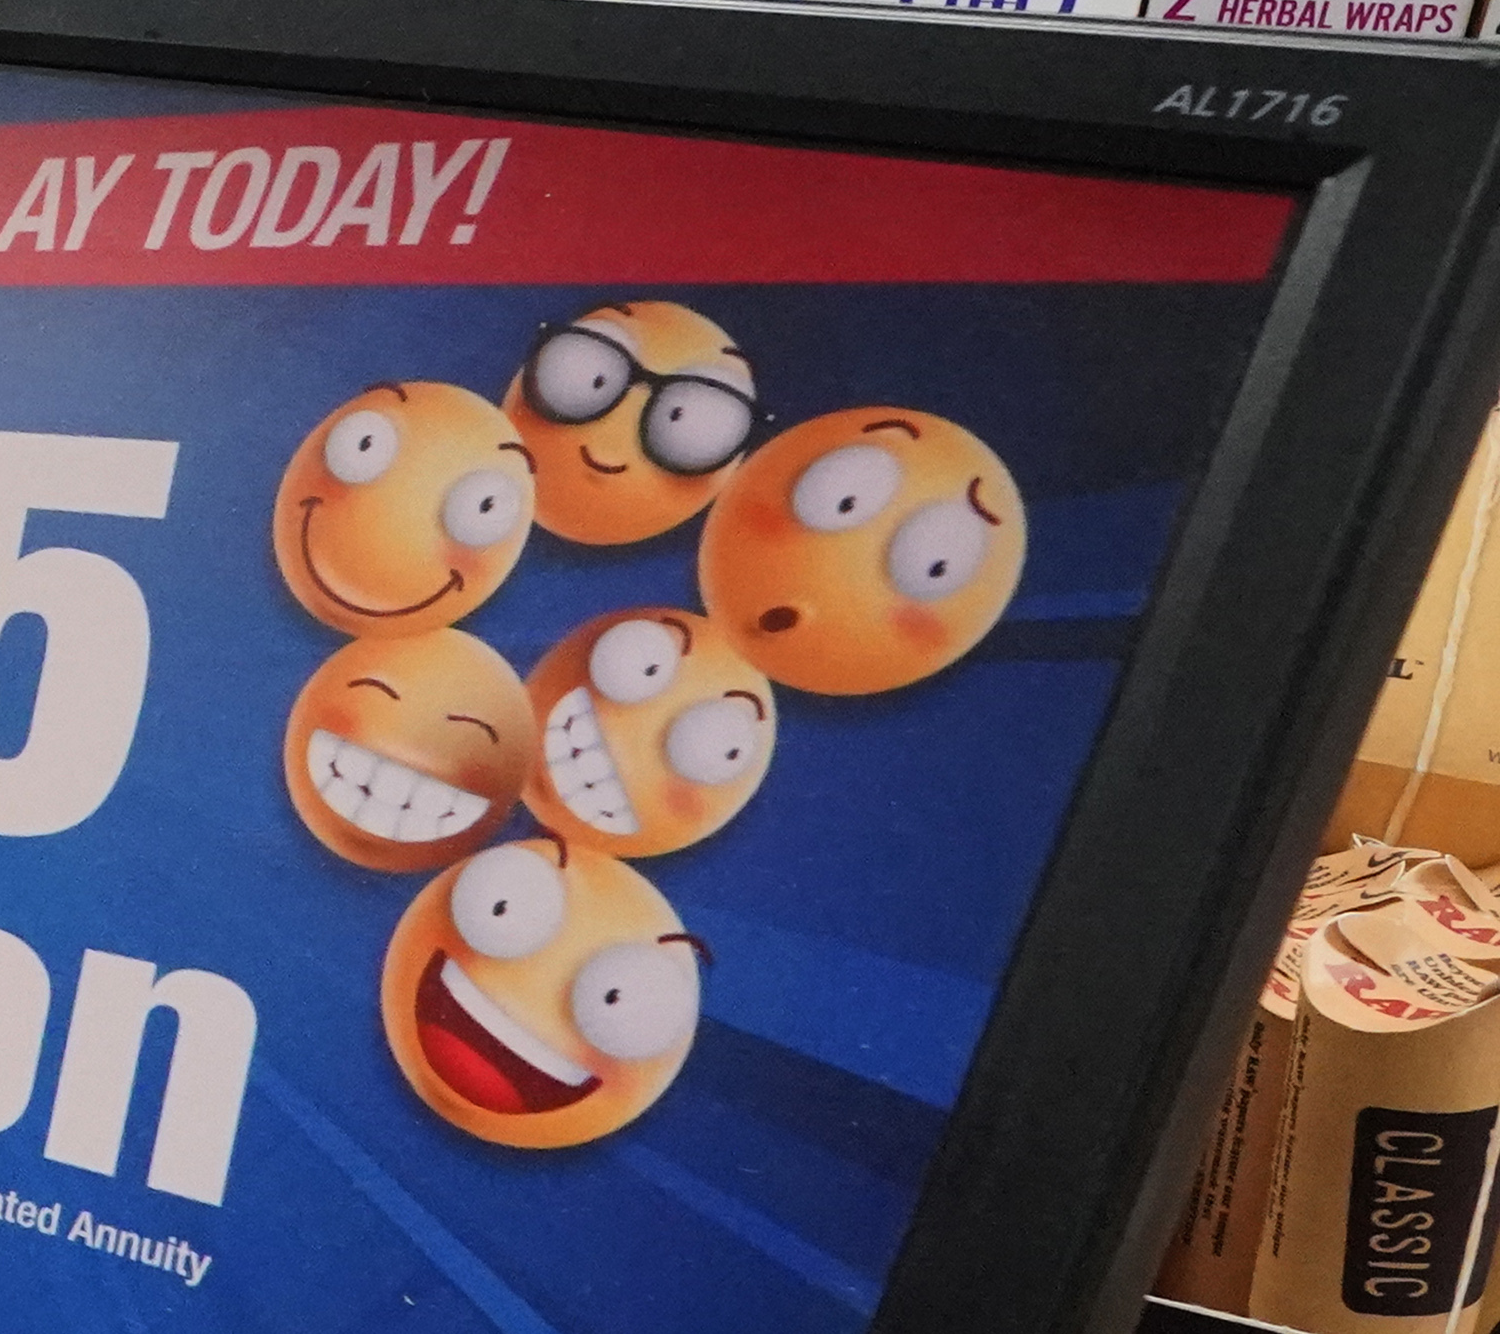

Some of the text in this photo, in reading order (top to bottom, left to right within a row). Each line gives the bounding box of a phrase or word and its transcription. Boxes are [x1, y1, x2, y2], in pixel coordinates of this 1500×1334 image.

[1344, 2, 1456, 34] WRAPS
[1153, 84, 1351, 127] AL1716
[145, 137, 510, 252] TODAY!
[67, 1209, 212, 1287] Annuity
[1364, 1131, 1444, 1298] CLASSIC
